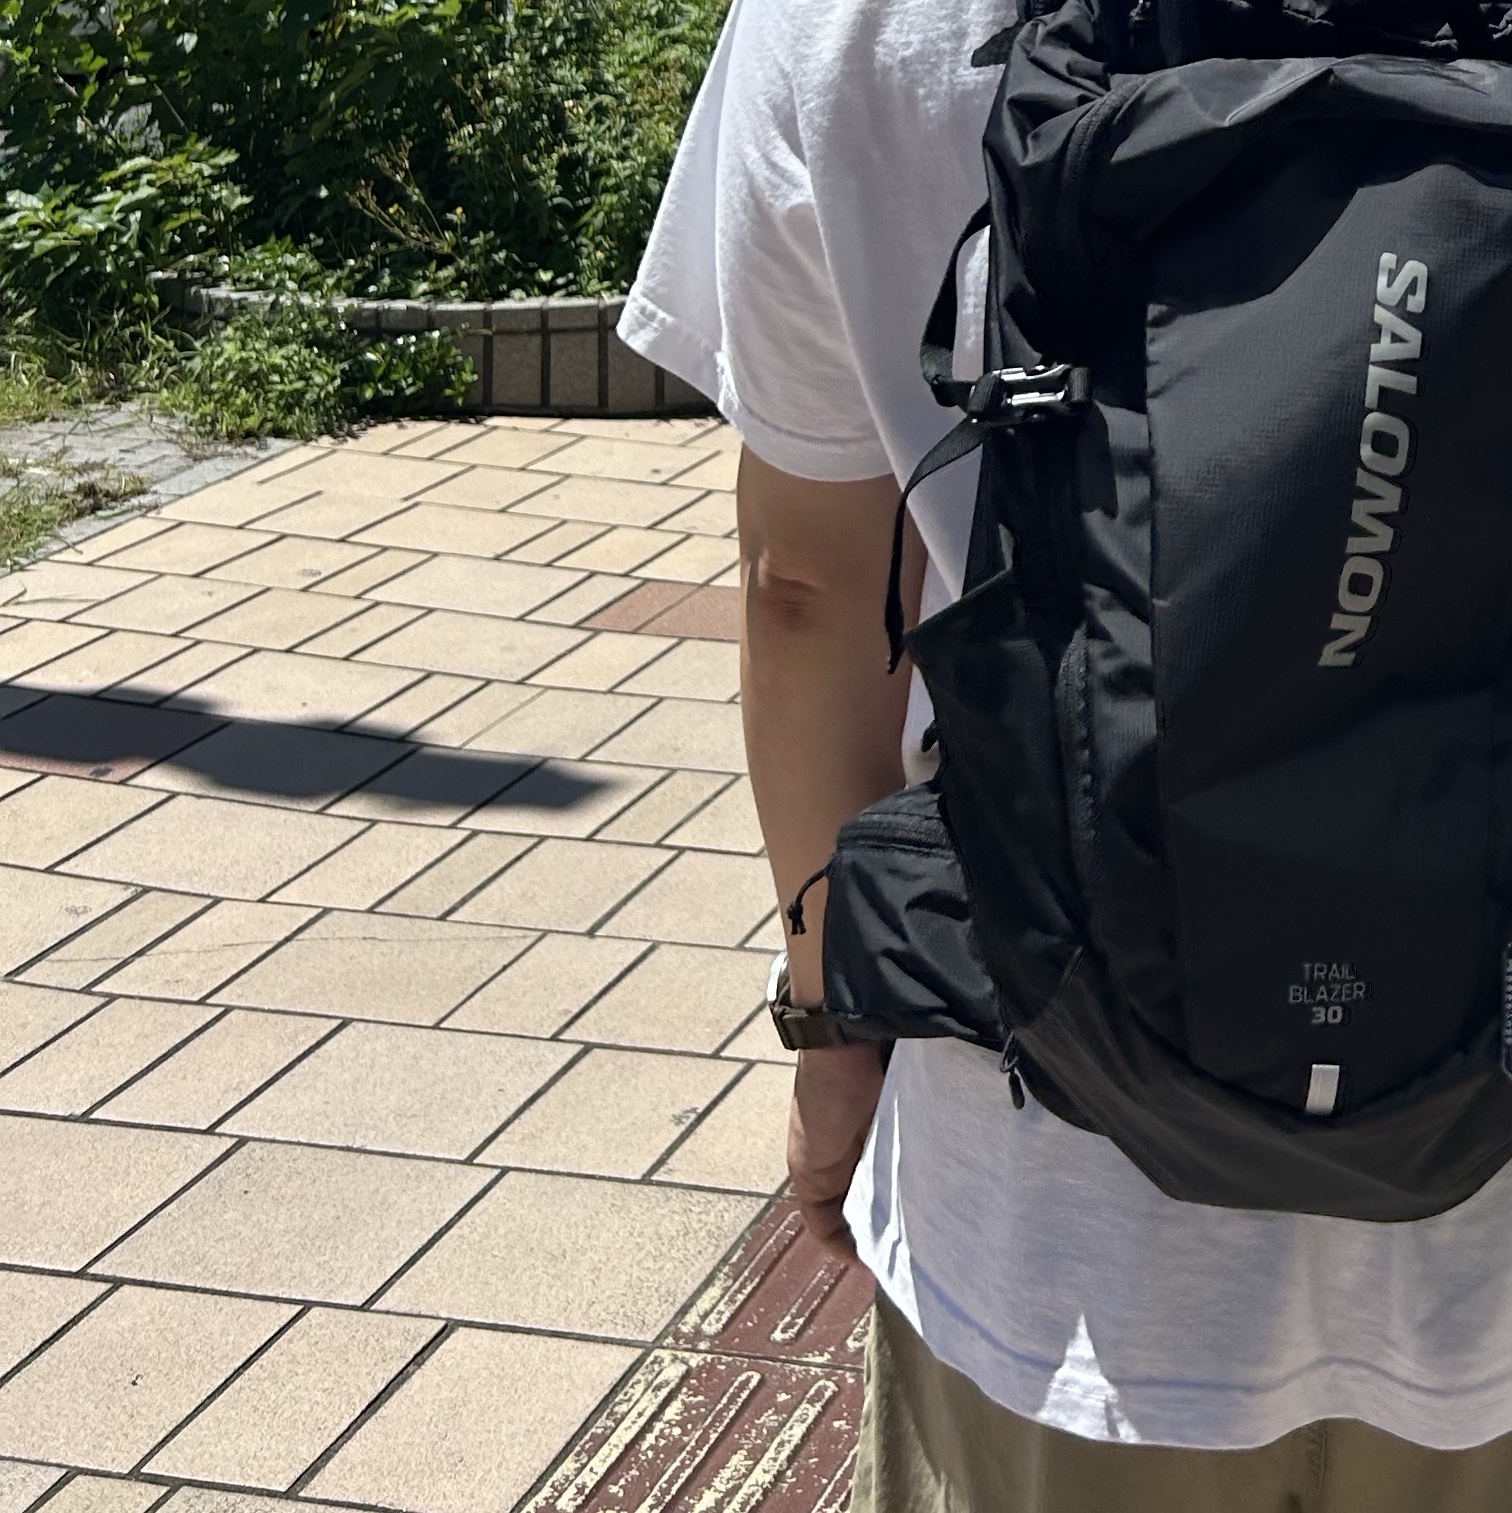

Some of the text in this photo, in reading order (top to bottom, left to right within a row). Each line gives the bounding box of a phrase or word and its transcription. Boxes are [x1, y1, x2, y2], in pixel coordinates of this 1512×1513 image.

[1317, 251, 1429, 668] SALOMON
[1303, 963, 1357, 981] TRAIL
[1288, 982, 1367, 1004] BLAZER
[1311, 1005, 1344, 1024] 30
